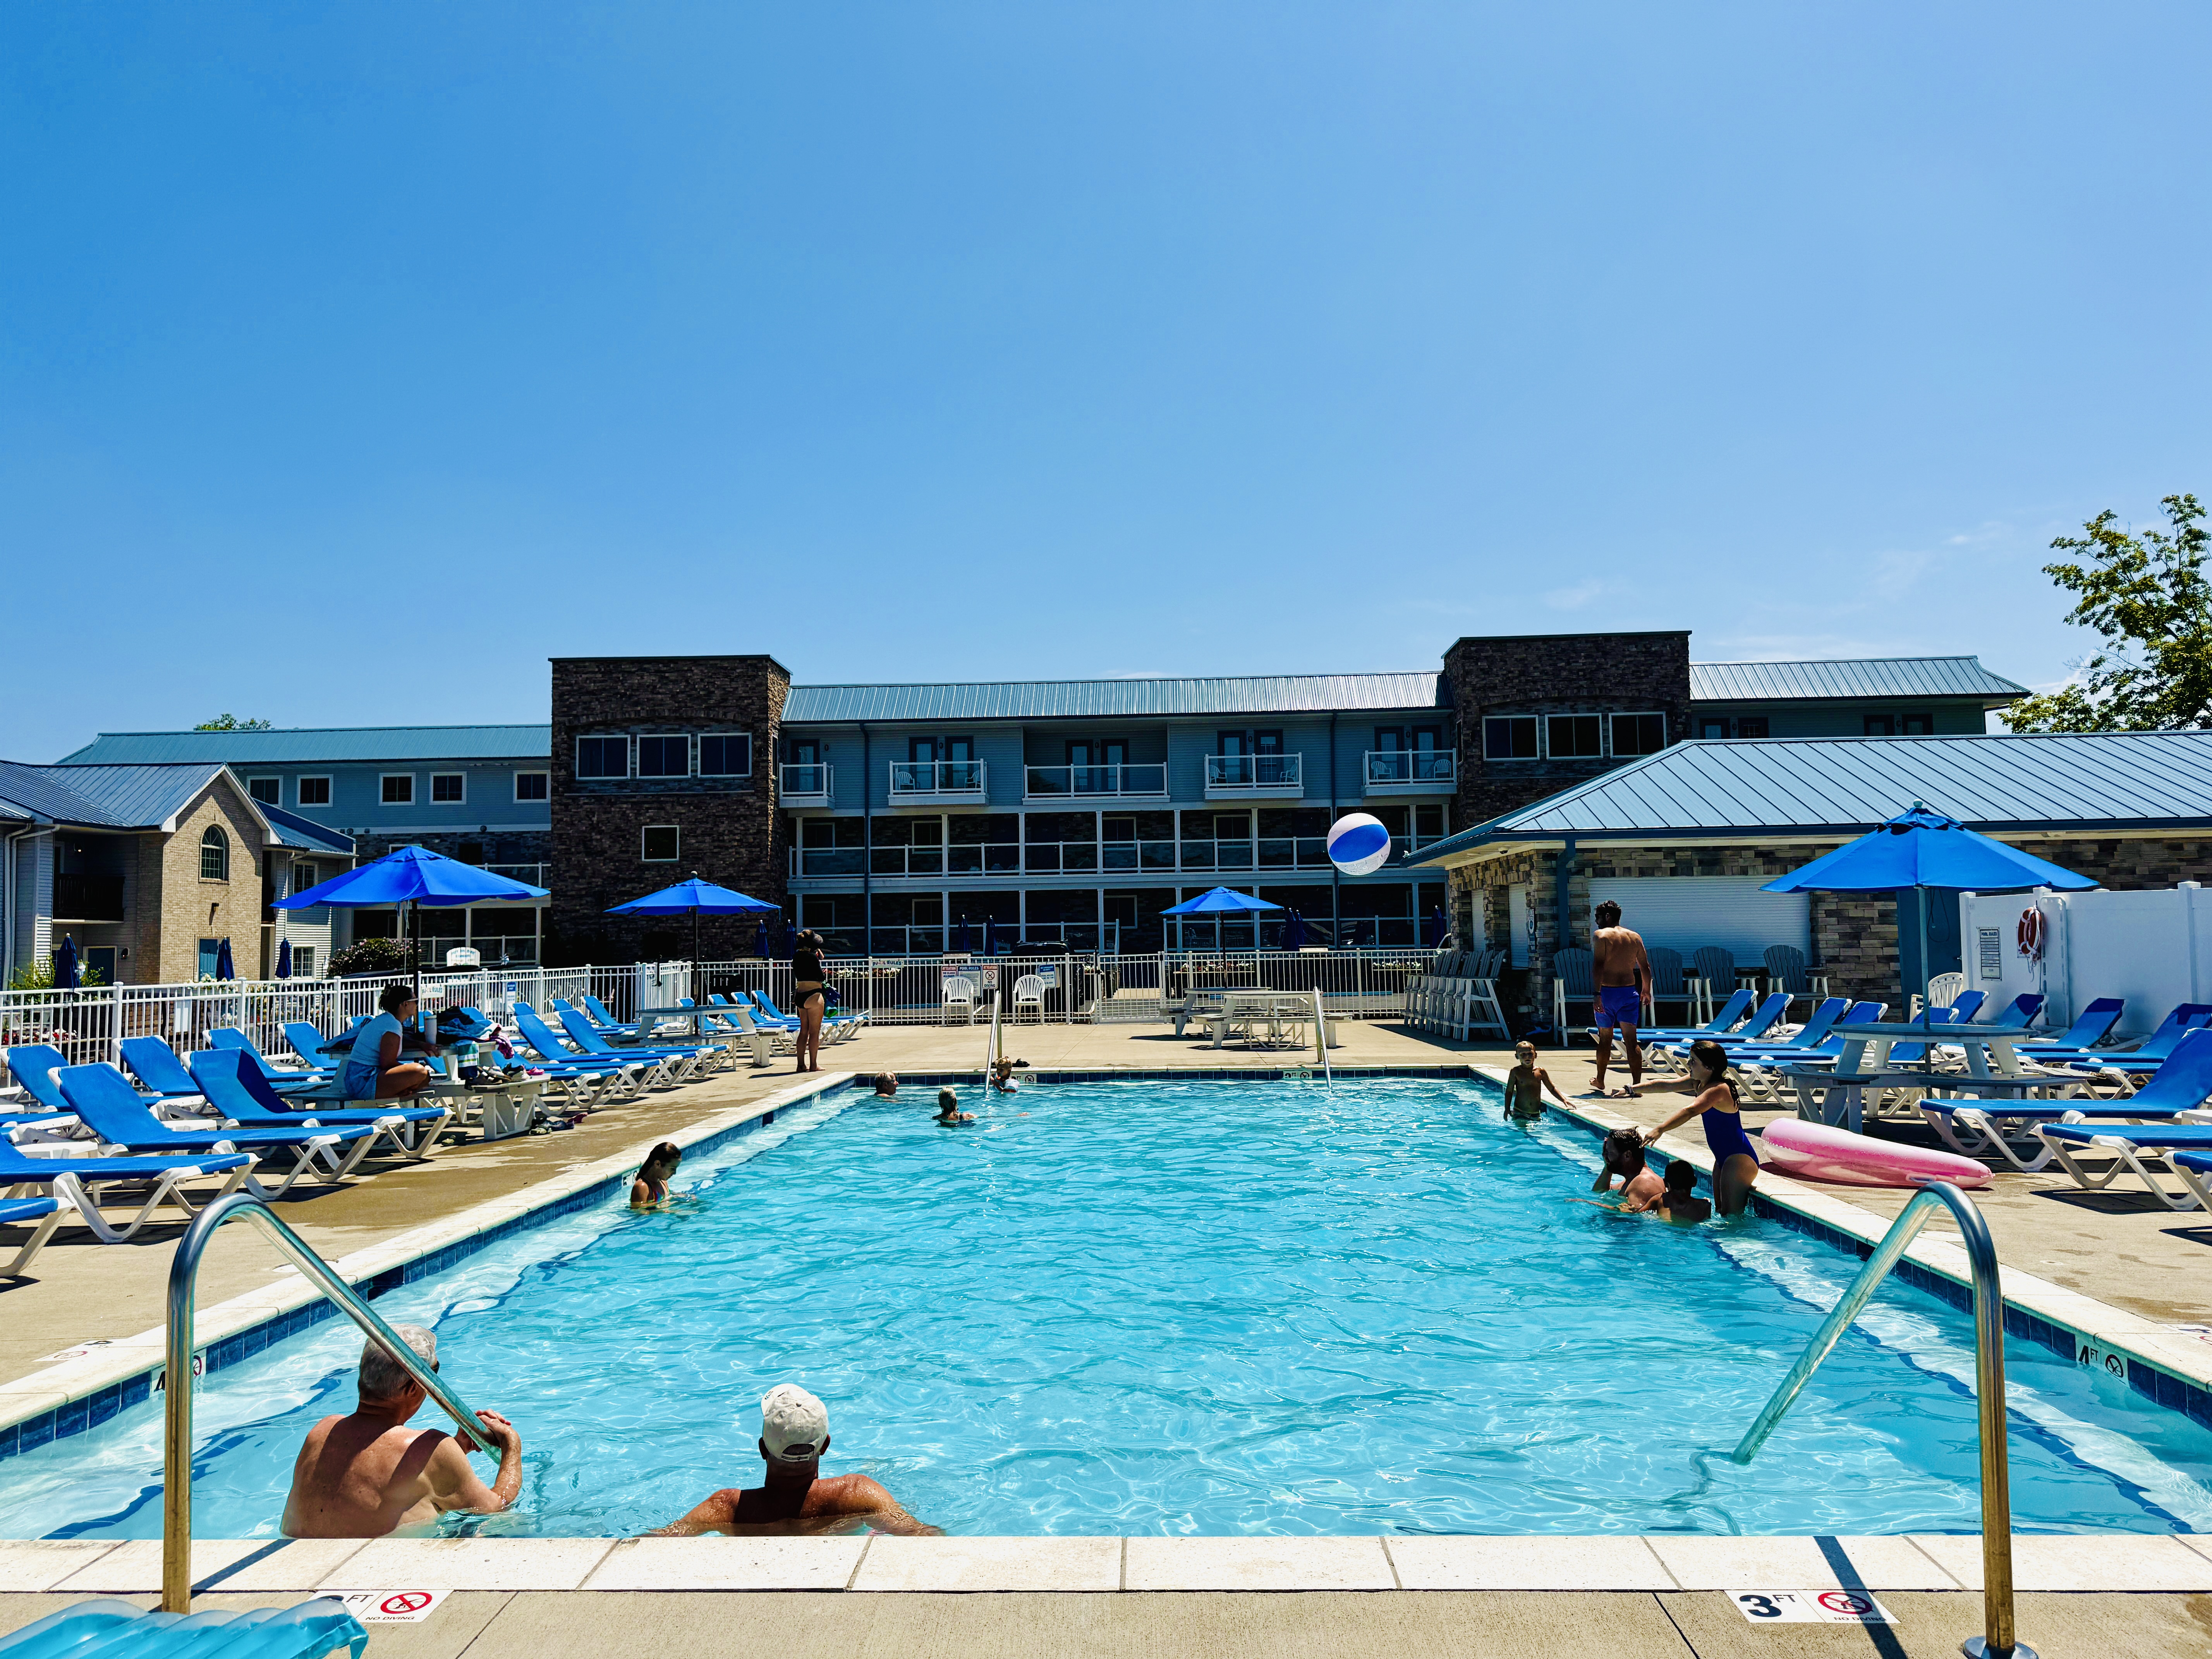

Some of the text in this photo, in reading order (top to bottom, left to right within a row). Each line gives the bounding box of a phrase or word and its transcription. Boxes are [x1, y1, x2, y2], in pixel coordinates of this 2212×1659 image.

[2090, 1348, 2099, 1361] FT
[1739, 1594, 1796, 1618] 3 FT
